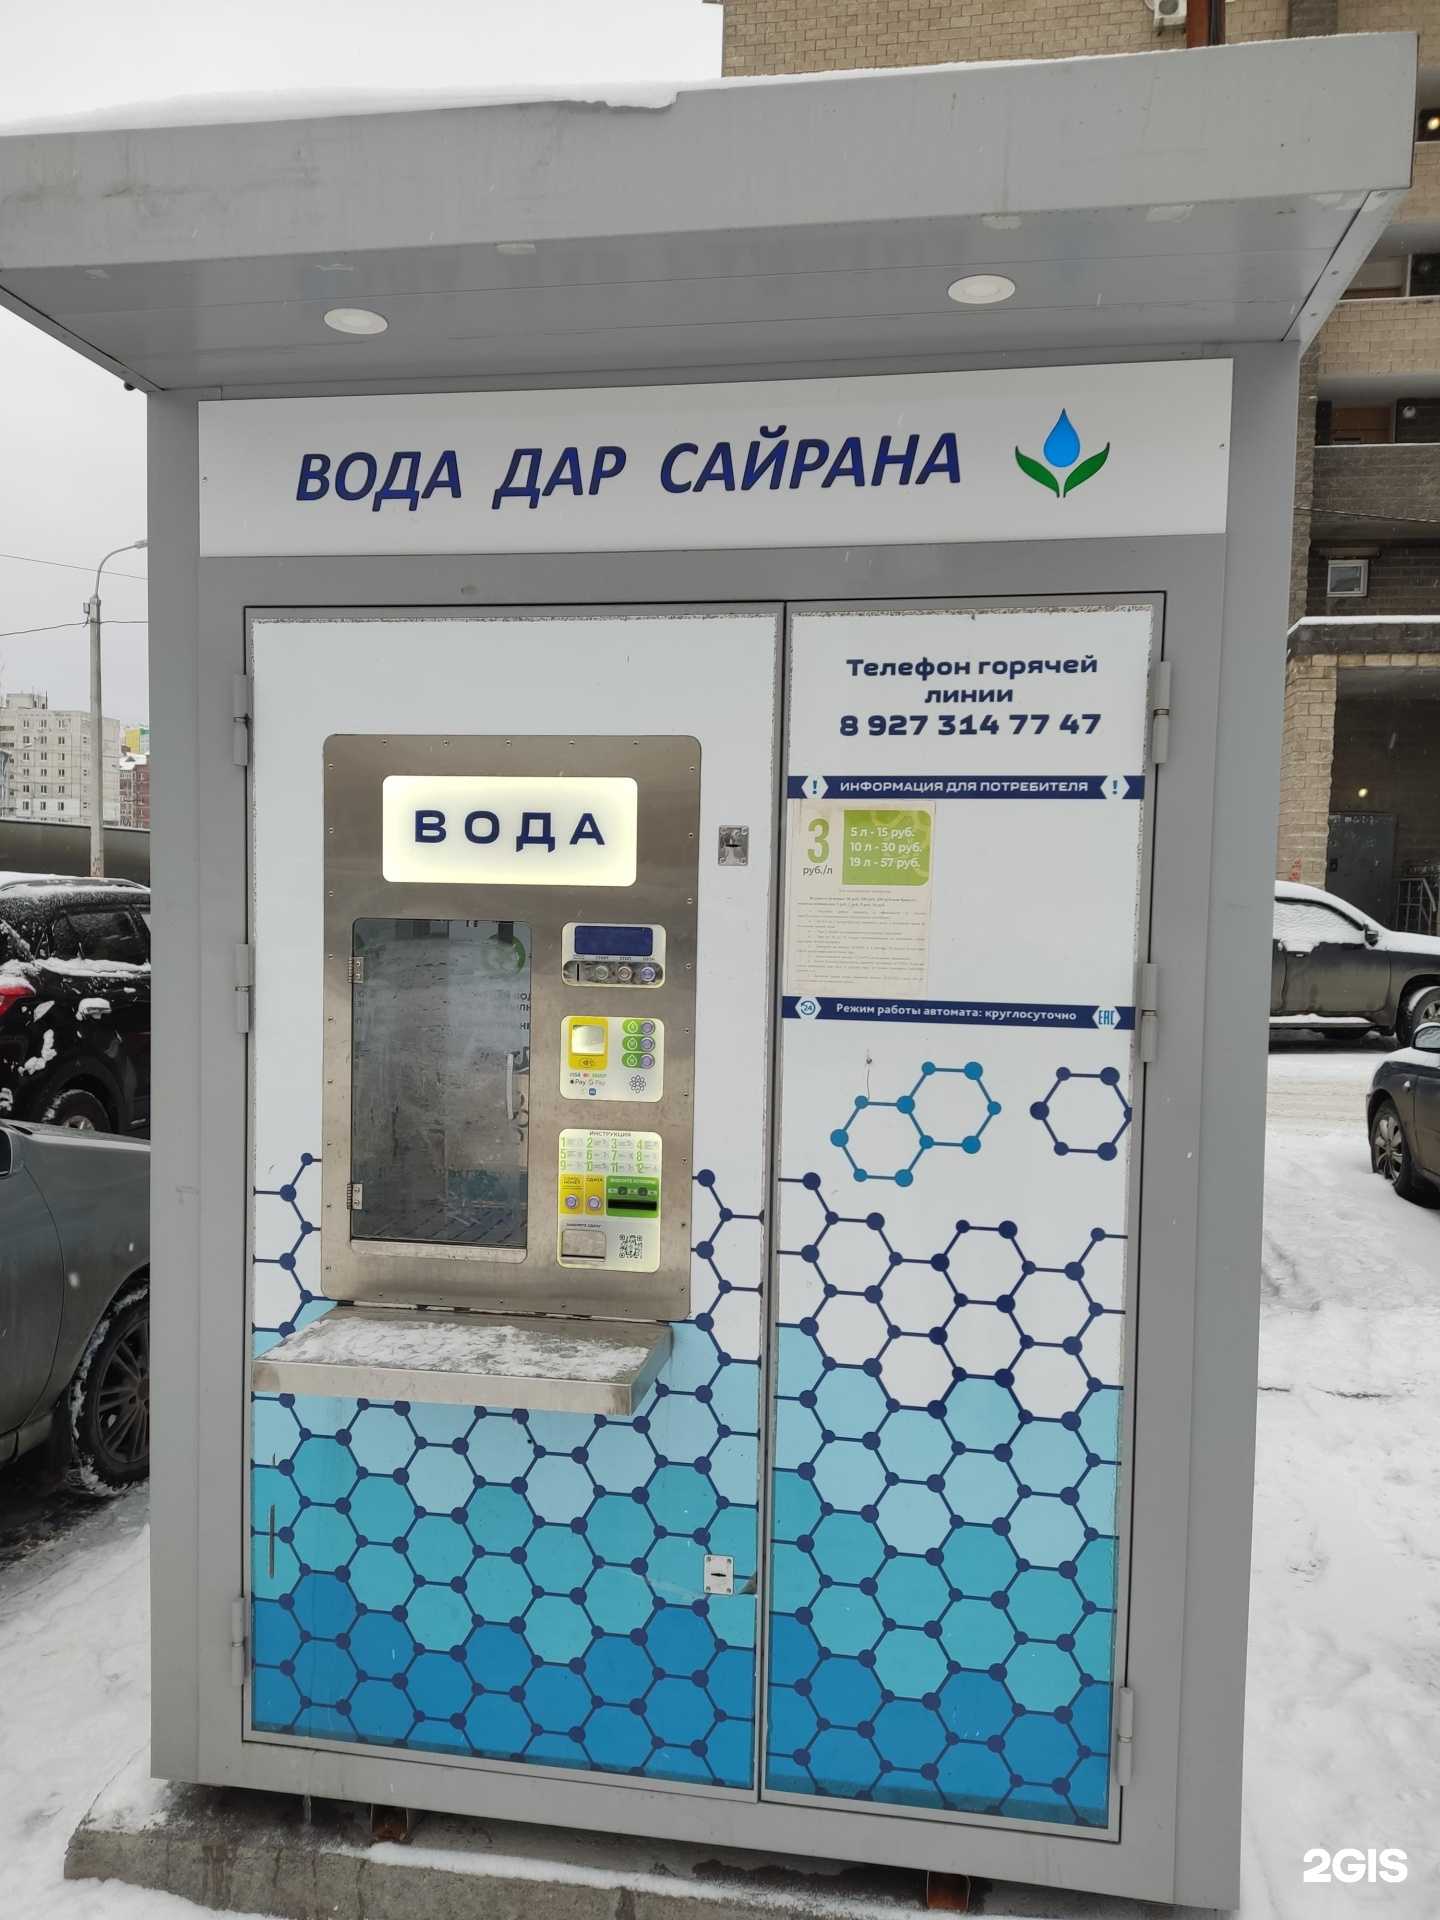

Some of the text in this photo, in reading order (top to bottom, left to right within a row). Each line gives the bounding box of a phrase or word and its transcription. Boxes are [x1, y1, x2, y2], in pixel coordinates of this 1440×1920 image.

[295, 424, 963, 514] ВОДА ДАР САЙРАНА
[846, 655, 1098, 680] Телефон горячей
[925, 689, 1014, 704] линии
[839, 713, 1102, 737] 8 927 314 77 47
[840, 781, 1089, 793] ИНФОРМАЦИЯ ДЛЯ ПОТРЕБИТЕЛЯ
[415, 809, 605, 853] ВОДА
[850, 828, 857, 837] 5
[877, 828, 888, 837] 15
[807, 818, 830, 864] 3
[850, 843, 862, 852] 10
[881, 843, 895, 852] 30
[850, 858, 861, 867] 19
[880, 858, 893, 867] 57
[836, 1003, 1077, 1021] Режим работы автомата: круглосуточно
